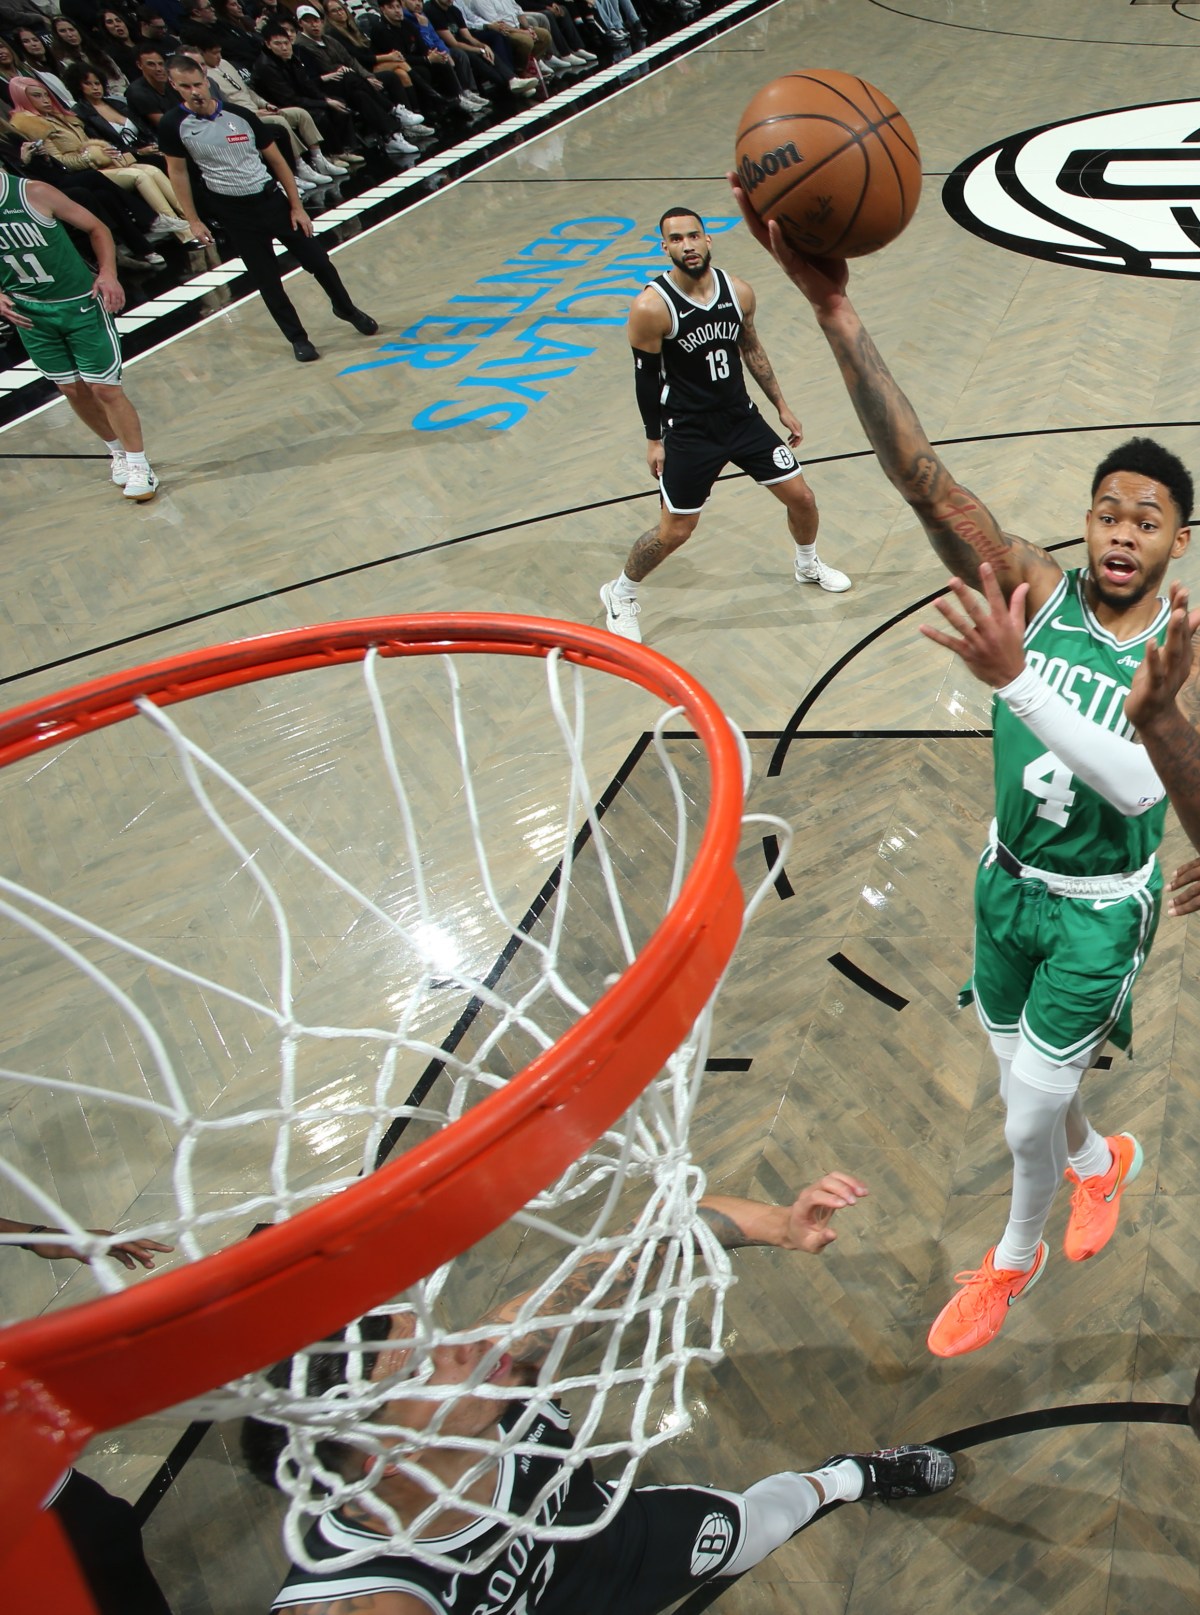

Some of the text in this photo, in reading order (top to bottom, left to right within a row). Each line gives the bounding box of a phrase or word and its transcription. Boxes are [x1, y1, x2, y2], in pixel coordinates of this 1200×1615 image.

[3, 253, 55, 285] 11
[337, 216, 636, 376] CENTER
[705, 348, 730, 381] 13
[1023, 751, 1077, 829] 4
